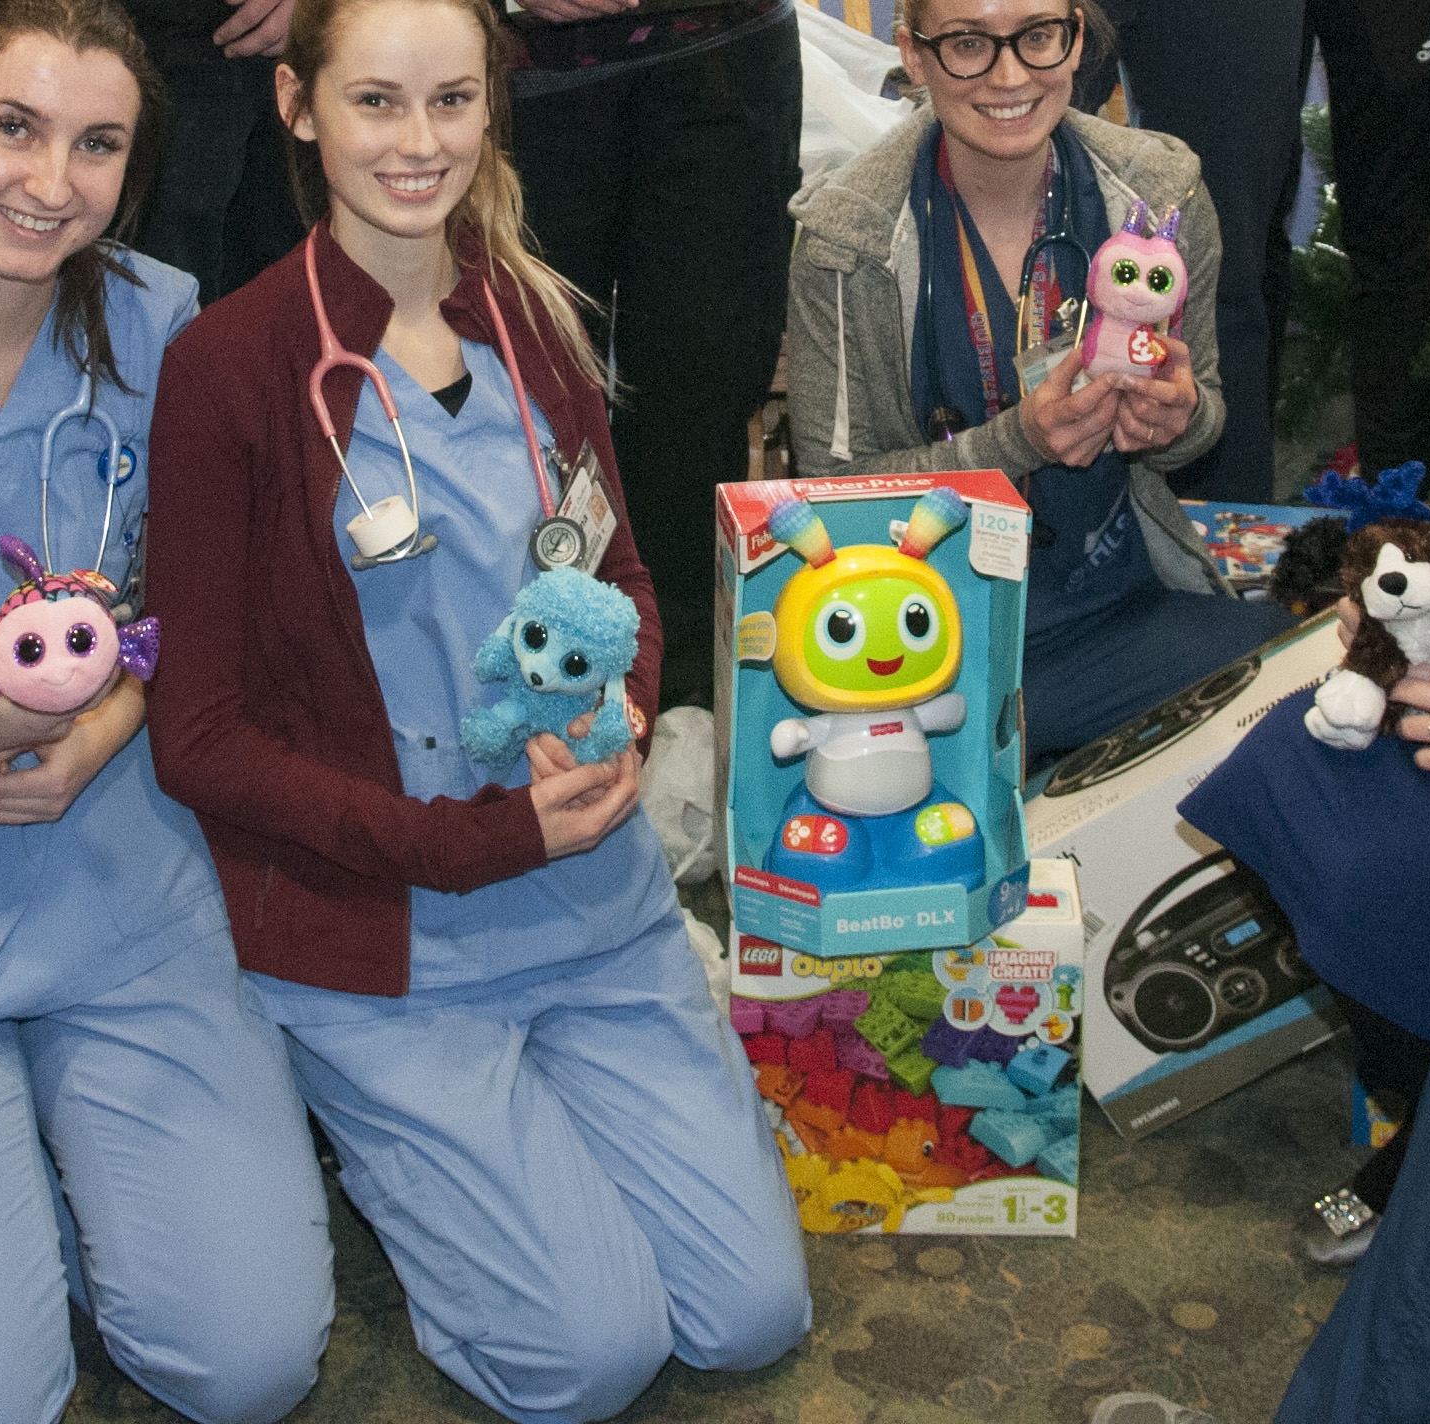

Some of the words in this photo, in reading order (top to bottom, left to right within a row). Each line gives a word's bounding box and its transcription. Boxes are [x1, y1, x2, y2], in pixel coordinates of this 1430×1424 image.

[979, 513, 1018, 532] 120+
[916, 908, 955, 927] DLX
[741, 947, 779, 964] LEGO
[988, 950, 1055, 966] IMAGINE
[991, 964, 1050, 979] CREATE
